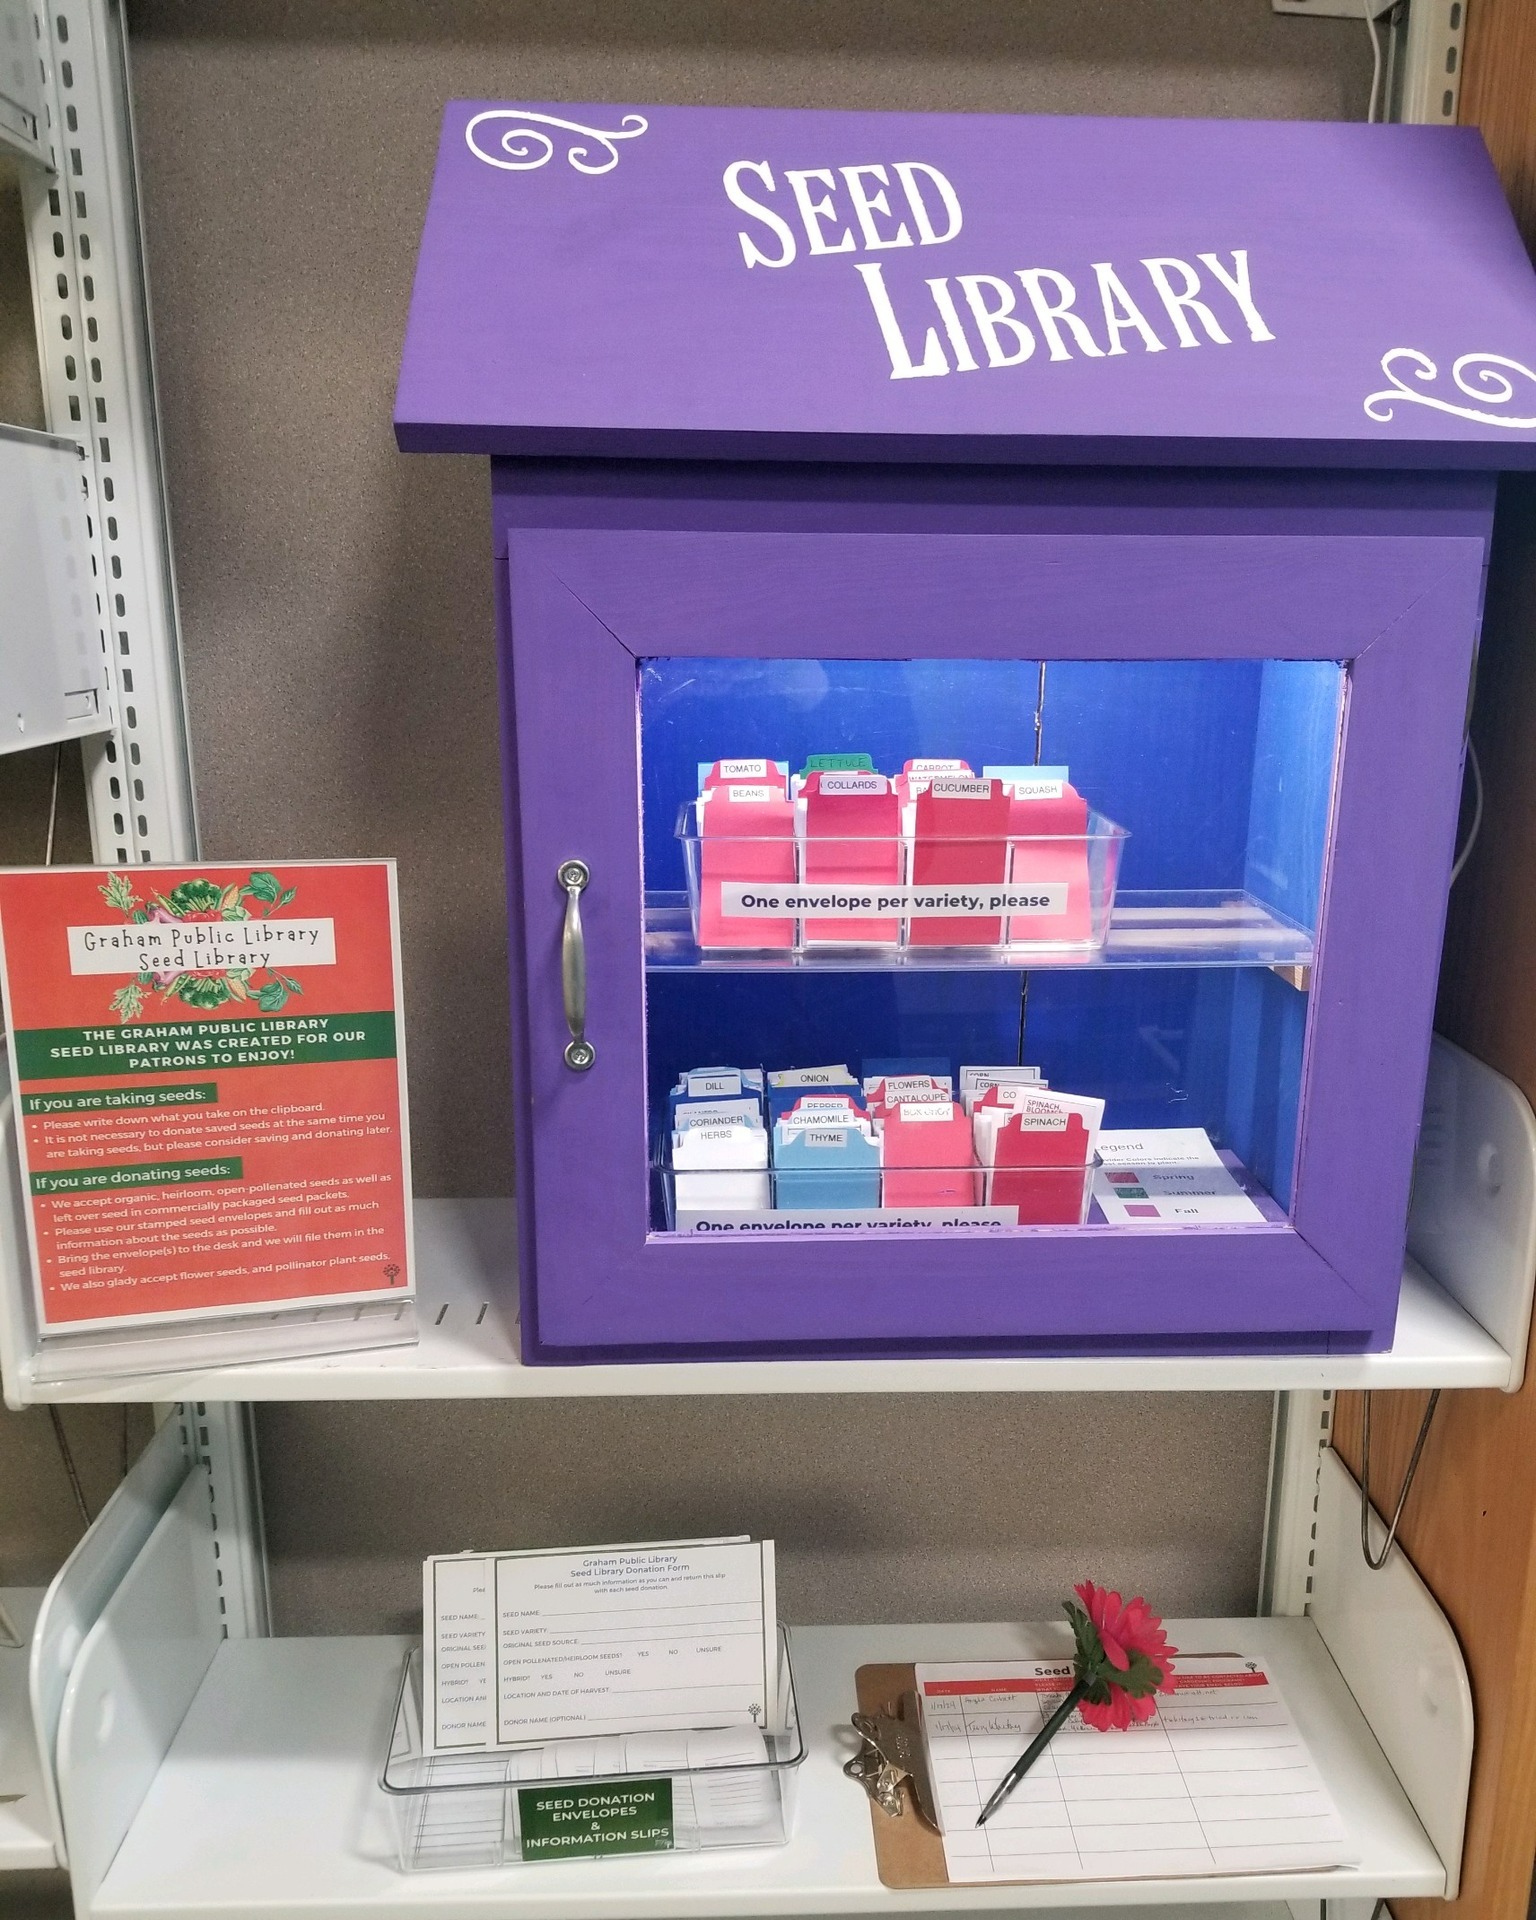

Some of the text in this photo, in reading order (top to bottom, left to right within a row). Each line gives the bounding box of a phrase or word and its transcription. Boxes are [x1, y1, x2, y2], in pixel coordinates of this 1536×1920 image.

[722, 159, 963, 269] SEED
[854, 249, 1277, 381] LIBRARY
[724, 764, 762, 774] TOMATO
[827, 780, 878, 790] COLLARDS
[933, 783, 990, 793] CUCUMBER
[1018, 786, 1058, 795] SQUASH
[732, 789, 765, 798] BEANS
[741, 894, 780, 908] One
[784, 894, 872, 911] envelope
[877, 897, 909, 911] per
[989, 893, 1050, 910] please
[84, 924, 319, 952] Graham Public Library
[139, 949, 272, 971] Seed Library
[82, 1018, 329, 1041] THE GRAHAM PUBLIC LIBRARY
[50, 1030, 365, 1058] SEED LIBRARY WAS CREATED FOR OUR
[129, 1049, 295, 1068] PATRONS TO ENJOY!
[800, 1074, 830, 1083] ONION
[888, 1080, 930, 1090] FLOWERS
[705, 1082, 724, 1091] DILL
[29, 1088, 206, 1112] If you are taking seeds:
[886, 1092, 947, 1104] CANTALOUPE
[43, 1102, 325, 1130] Please write down what you take on the clipboard.
[689, 1115, 744, 1127] CORIANDER
[793, 1114, 849, 1125] CHAMOMILE
[1023, 1118, 1067, 1126] SPINACH
[44, 1113, 385, 1144] It is not necessary to donate saved seeds at the same time you
[700, 1130, 733, 1140] HERBS
[45, 1150, 66, 1158] are
[67, 1146, 104, 1157] taking
[143, 1142, 164, 1151] but
[166, 1140, 203, 1151] please
[204, 1135, 252, 1147] consider
[253, 1133, 289, 1143] saving
[290, 1130, 312, 1140] and
[314, 1127, 364, 1138] donating
[366, 1125, 393, 1135] later.
[809, 1133, 843, 1142] THYME
[1101, 1143, 1144, 1152] egend
[35, 1164, 230, 1191] If you are donating seeds:
[50, 1199, 71, 1208] We
[72, 1196, 113, 1207] accept
[216, 1179, 307, 1196] open-pollenated
[309, 1177, 340, 1187] seeds
[341, 1177, 354, 1185] as
[354, 1173, 378, 1184] well
[379, 1174, 392, 1182] as
[52, 1191, 349, 1222] left over seed in commercially packaged seed packets.
[59, 1282, 80, 1291] We
[81, 1279, 105, 1289] also
[106, 1276, 138, 1288] glady
[139, 1273, 178, 1284] accept
[179, 1270, 215, 1280] flower
[251, 1263, 273, 1273] and
[275, 1259, 327, 1273] pollinator
[329, 1255, 357, 1267] plant
[358, 1251, 390, 1262] seeds.
[582, 1555, 678, 1567] Graham Public Library
[570, 1564, 690, 1578] Seed Library Donation Form
[1034, 1667, 1071, 1676] Seed
[536, 1792, 655, 1811] SEED DONATION
[552, 1806, 637, 1822] ENVELOPES
[590, 1821, 600, 1831] &
[526, 1827, 669, 1848] INFORMATION SLIPS
